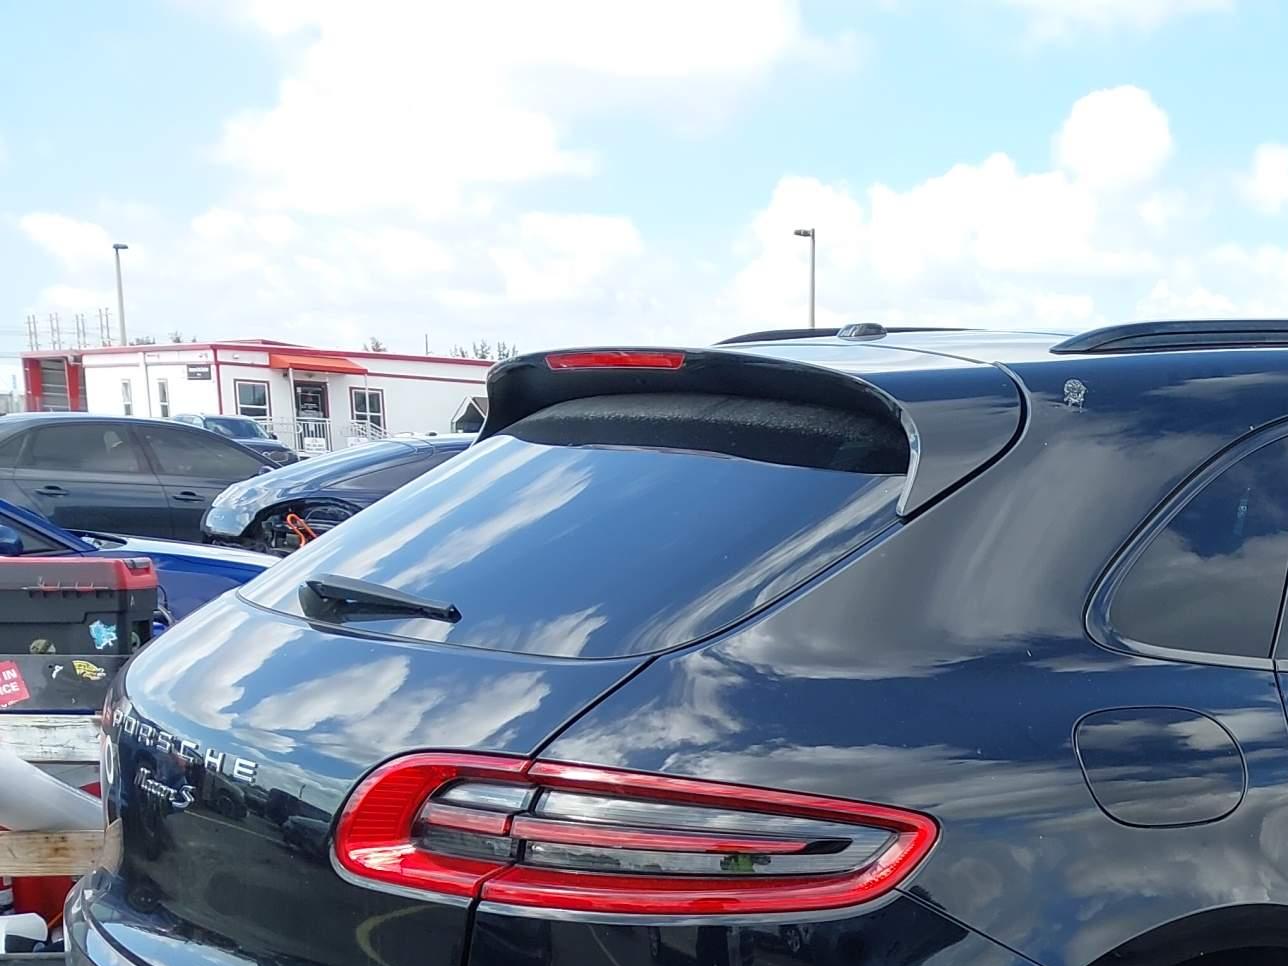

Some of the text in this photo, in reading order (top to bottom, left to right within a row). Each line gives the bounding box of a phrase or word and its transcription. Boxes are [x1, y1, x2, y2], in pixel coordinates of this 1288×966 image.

[2, 668, 17, 681] IN
[112, 708, 260, 785] PORSCHE
[171, 785, 197, 809] S
